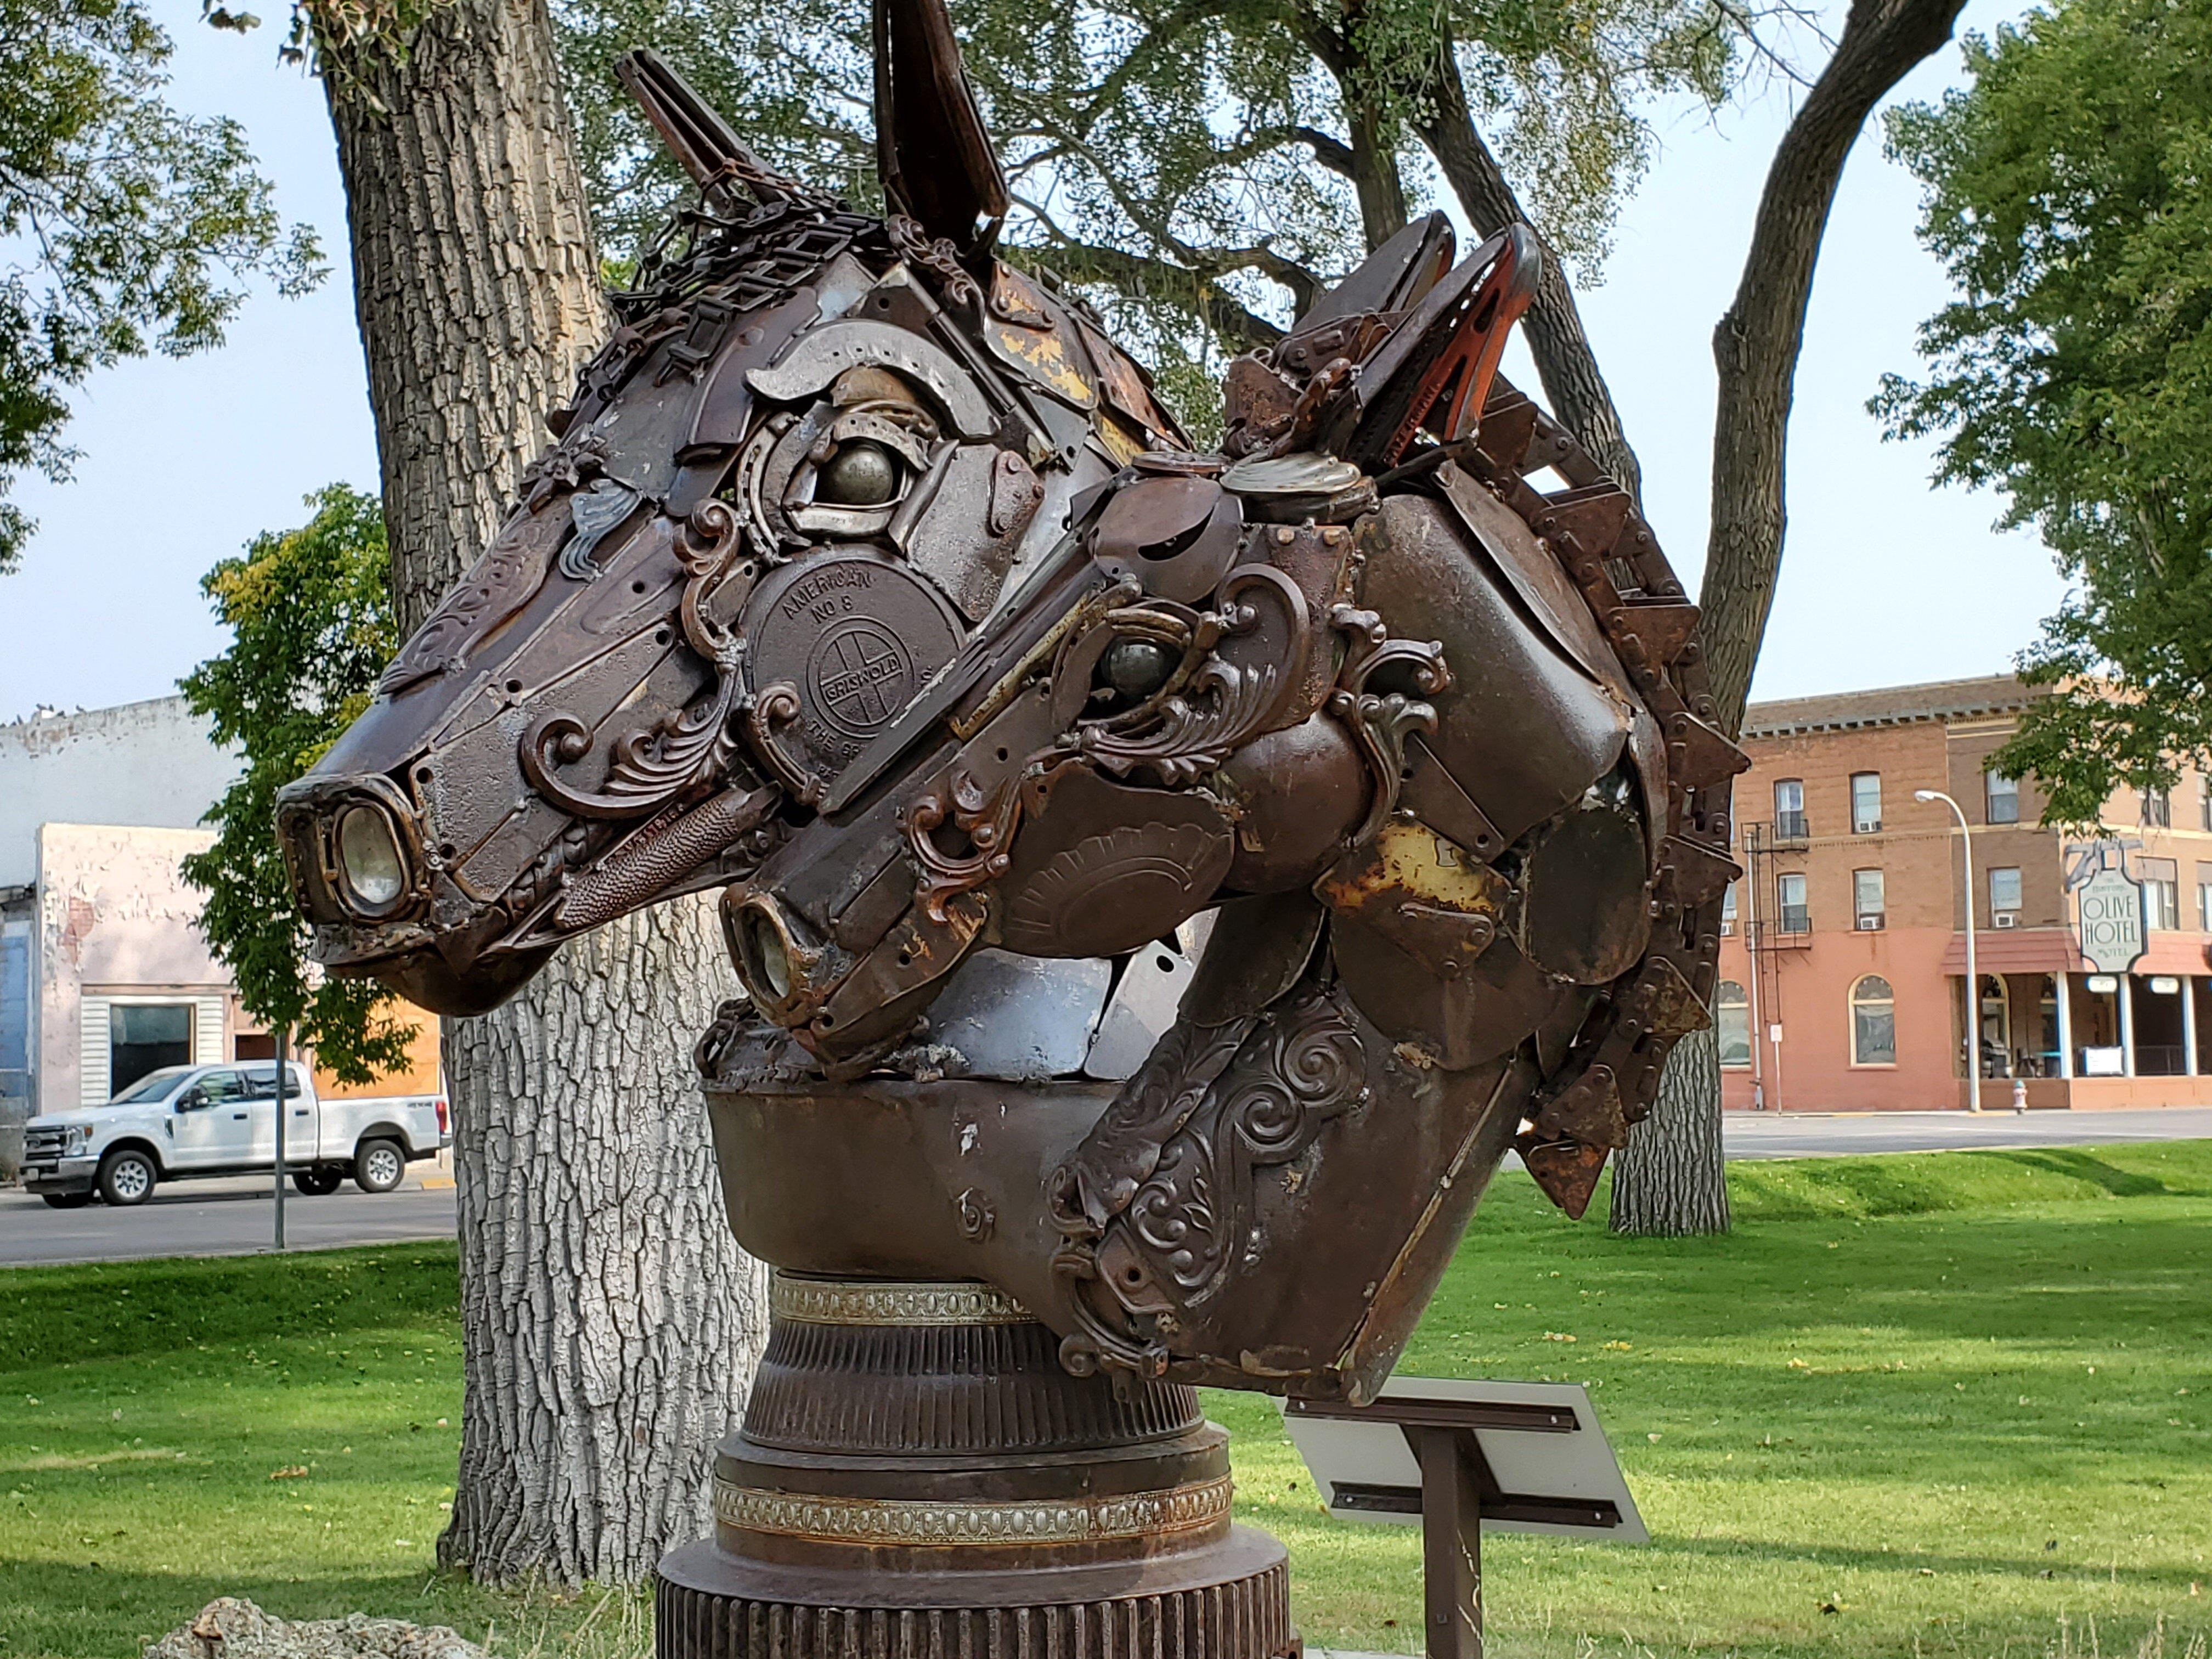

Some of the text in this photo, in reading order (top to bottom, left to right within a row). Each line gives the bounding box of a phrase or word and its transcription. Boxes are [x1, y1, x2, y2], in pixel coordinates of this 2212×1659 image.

[782, 568, 872, 620] AMERICAN
[811, 599, 836, 624] NO
[825, 657, 899, 700] GRISWOLD
[2083, 895, 2134, 920] OLIVE
[2085, 920, 2138, 945] HOTEL
